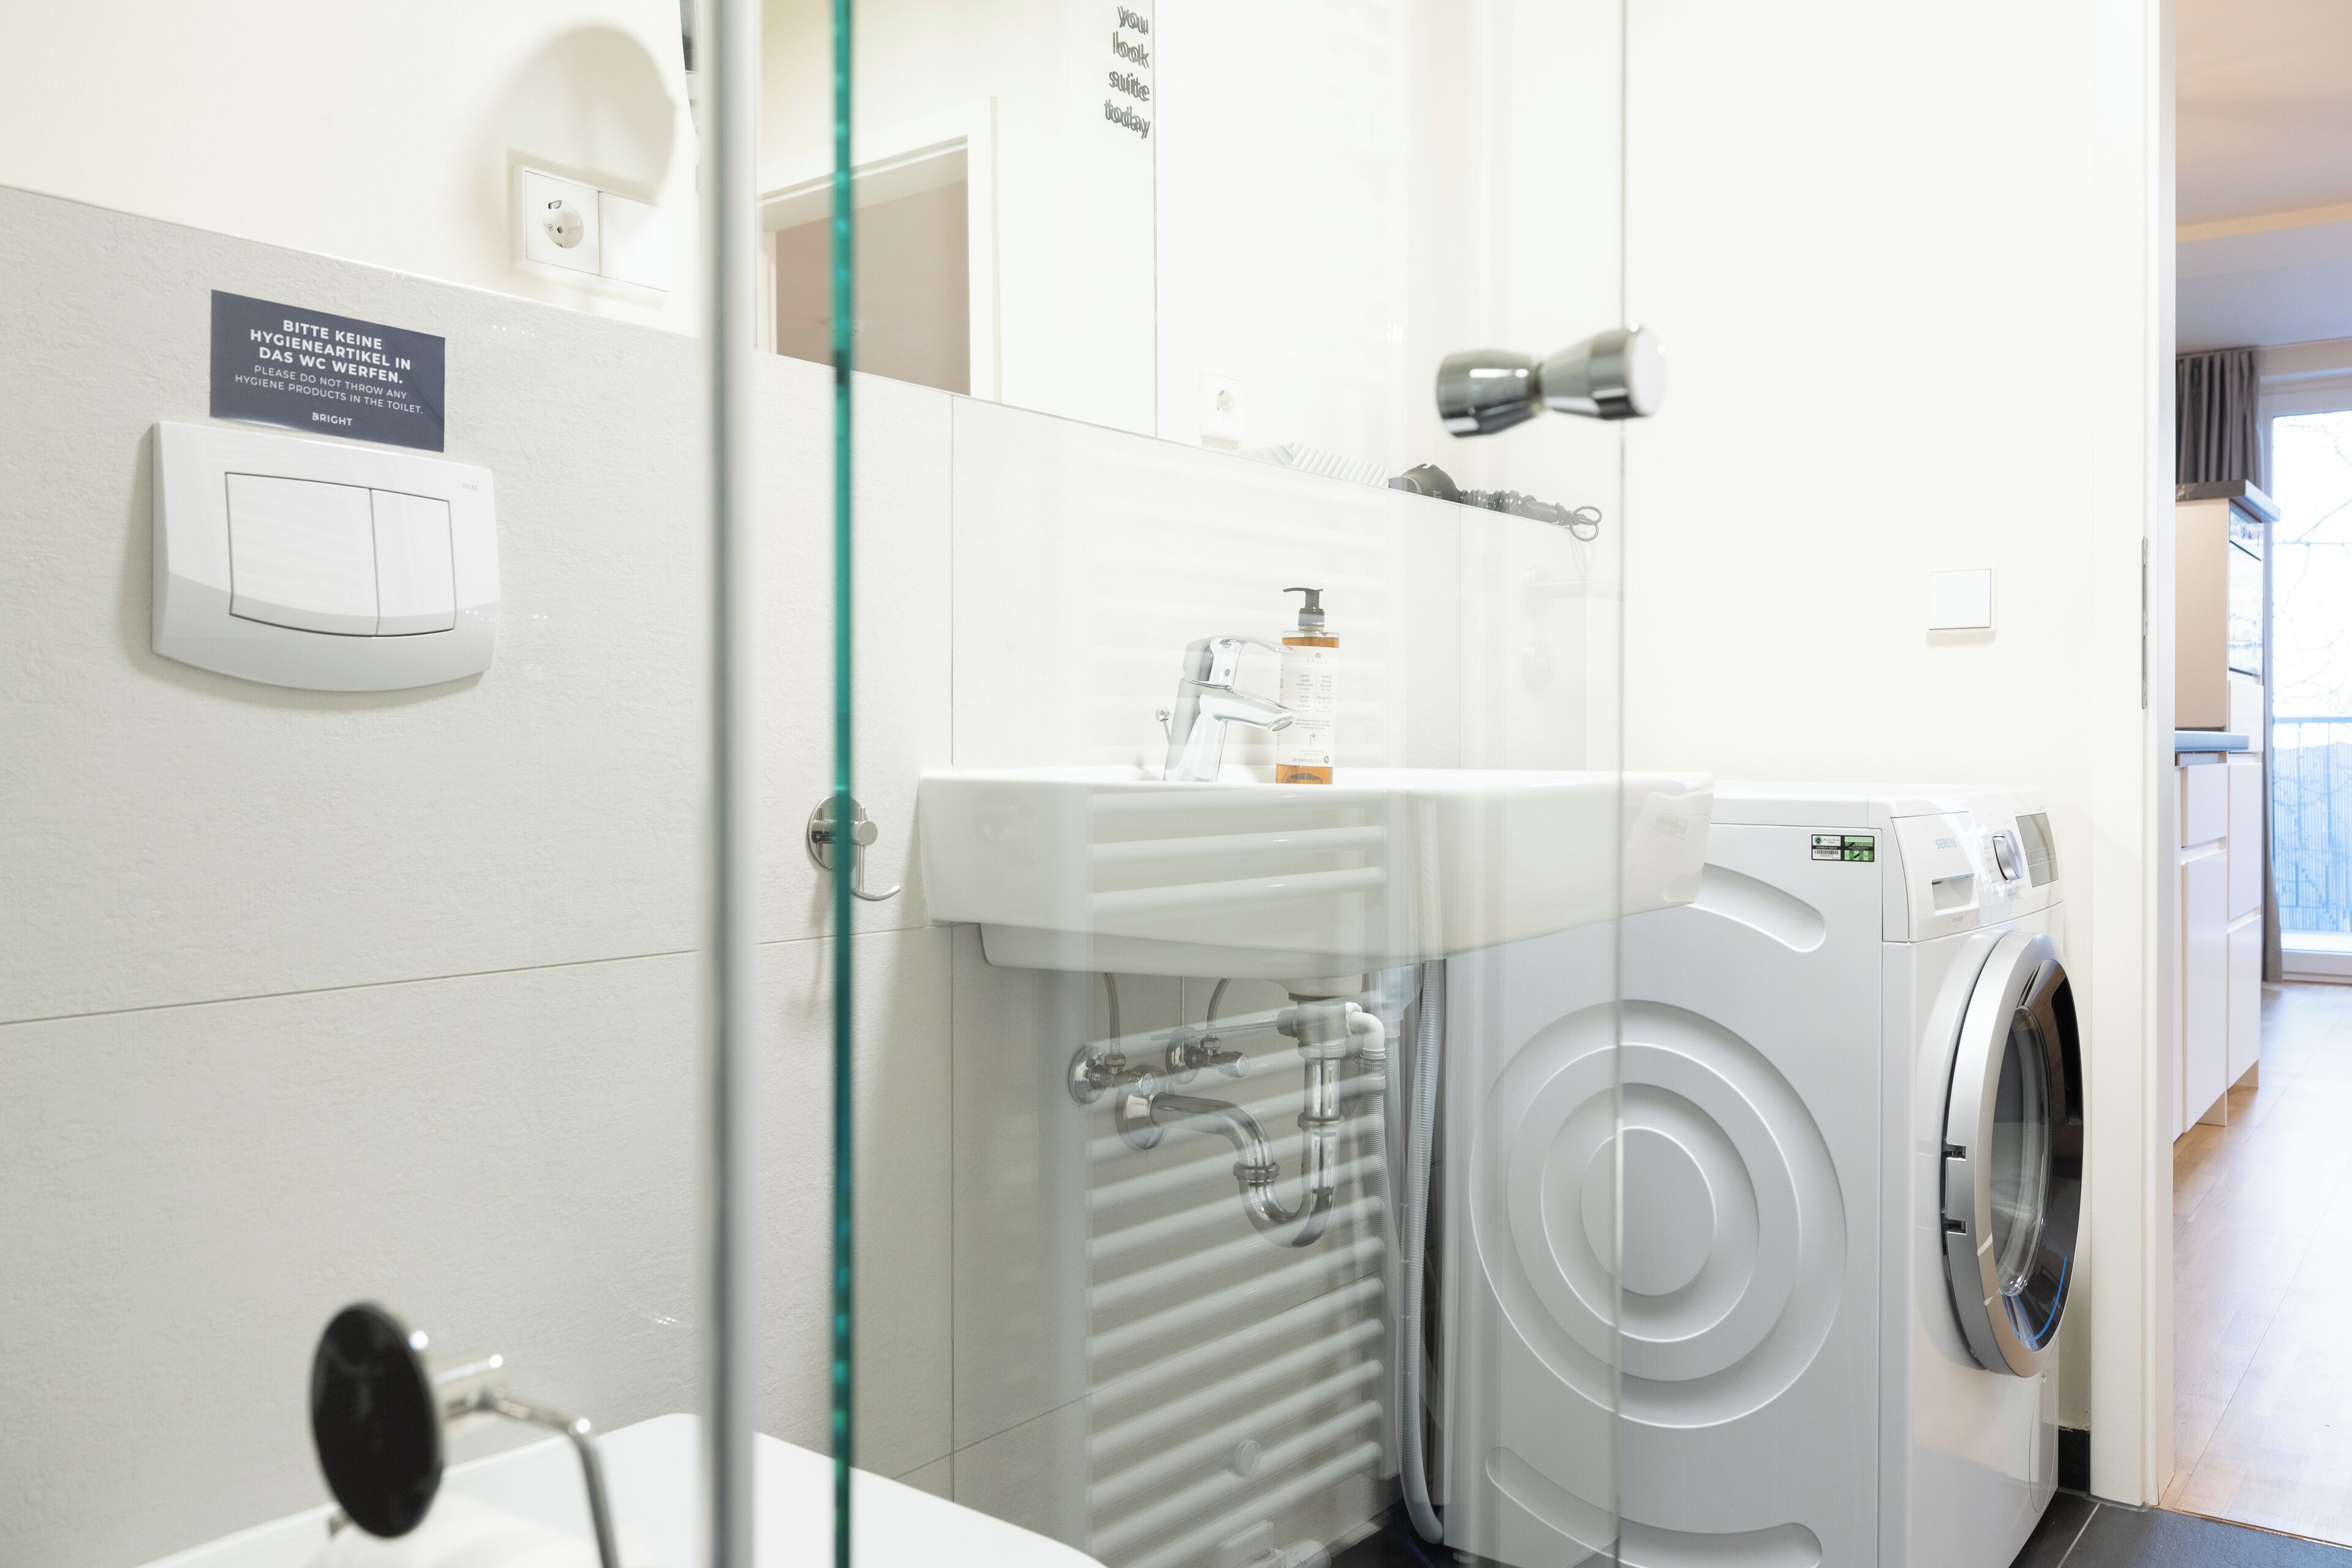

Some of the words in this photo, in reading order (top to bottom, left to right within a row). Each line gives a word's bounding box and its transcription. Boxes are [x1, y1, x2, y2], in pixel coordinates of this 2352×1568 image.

[1117, 6, 1148, 35] you
[1113, 31, 1150, 69] look
[1109, 71, 1150, 102] suite
[1104, 99, 1150, 139] today
[251, 329, 390, 367] HYGIENEARTIKEL
[396, 357, 410, 370] IN
[283, 320, 329, 339] BITTE
[336, 331, 382, 350] KEINE
[255, 365, 296, 380] PLEASE
[300, 373, 315, 383] DO
[320, 377, 341, 388] NOT
[345, 381, 383, 395] THROW
[386, 390, 407, 399] ANY
[259, 347, 293, 363] DAS
[300, 356, 326, 369] WC
[332, 360, 403, 384] WERFEN.
[235, 374, 284, 390] HYGIENE
[288, 383, 346, 401] PRODUCTS
[350, 394, 360, 403] IN
[364, 396, 383, 407] THE
[387, 400, 423, 414] TOILET.
[312, 412, 352, 426] BRIGHT
[1935, 837, 1957, 850] SIEMENS
